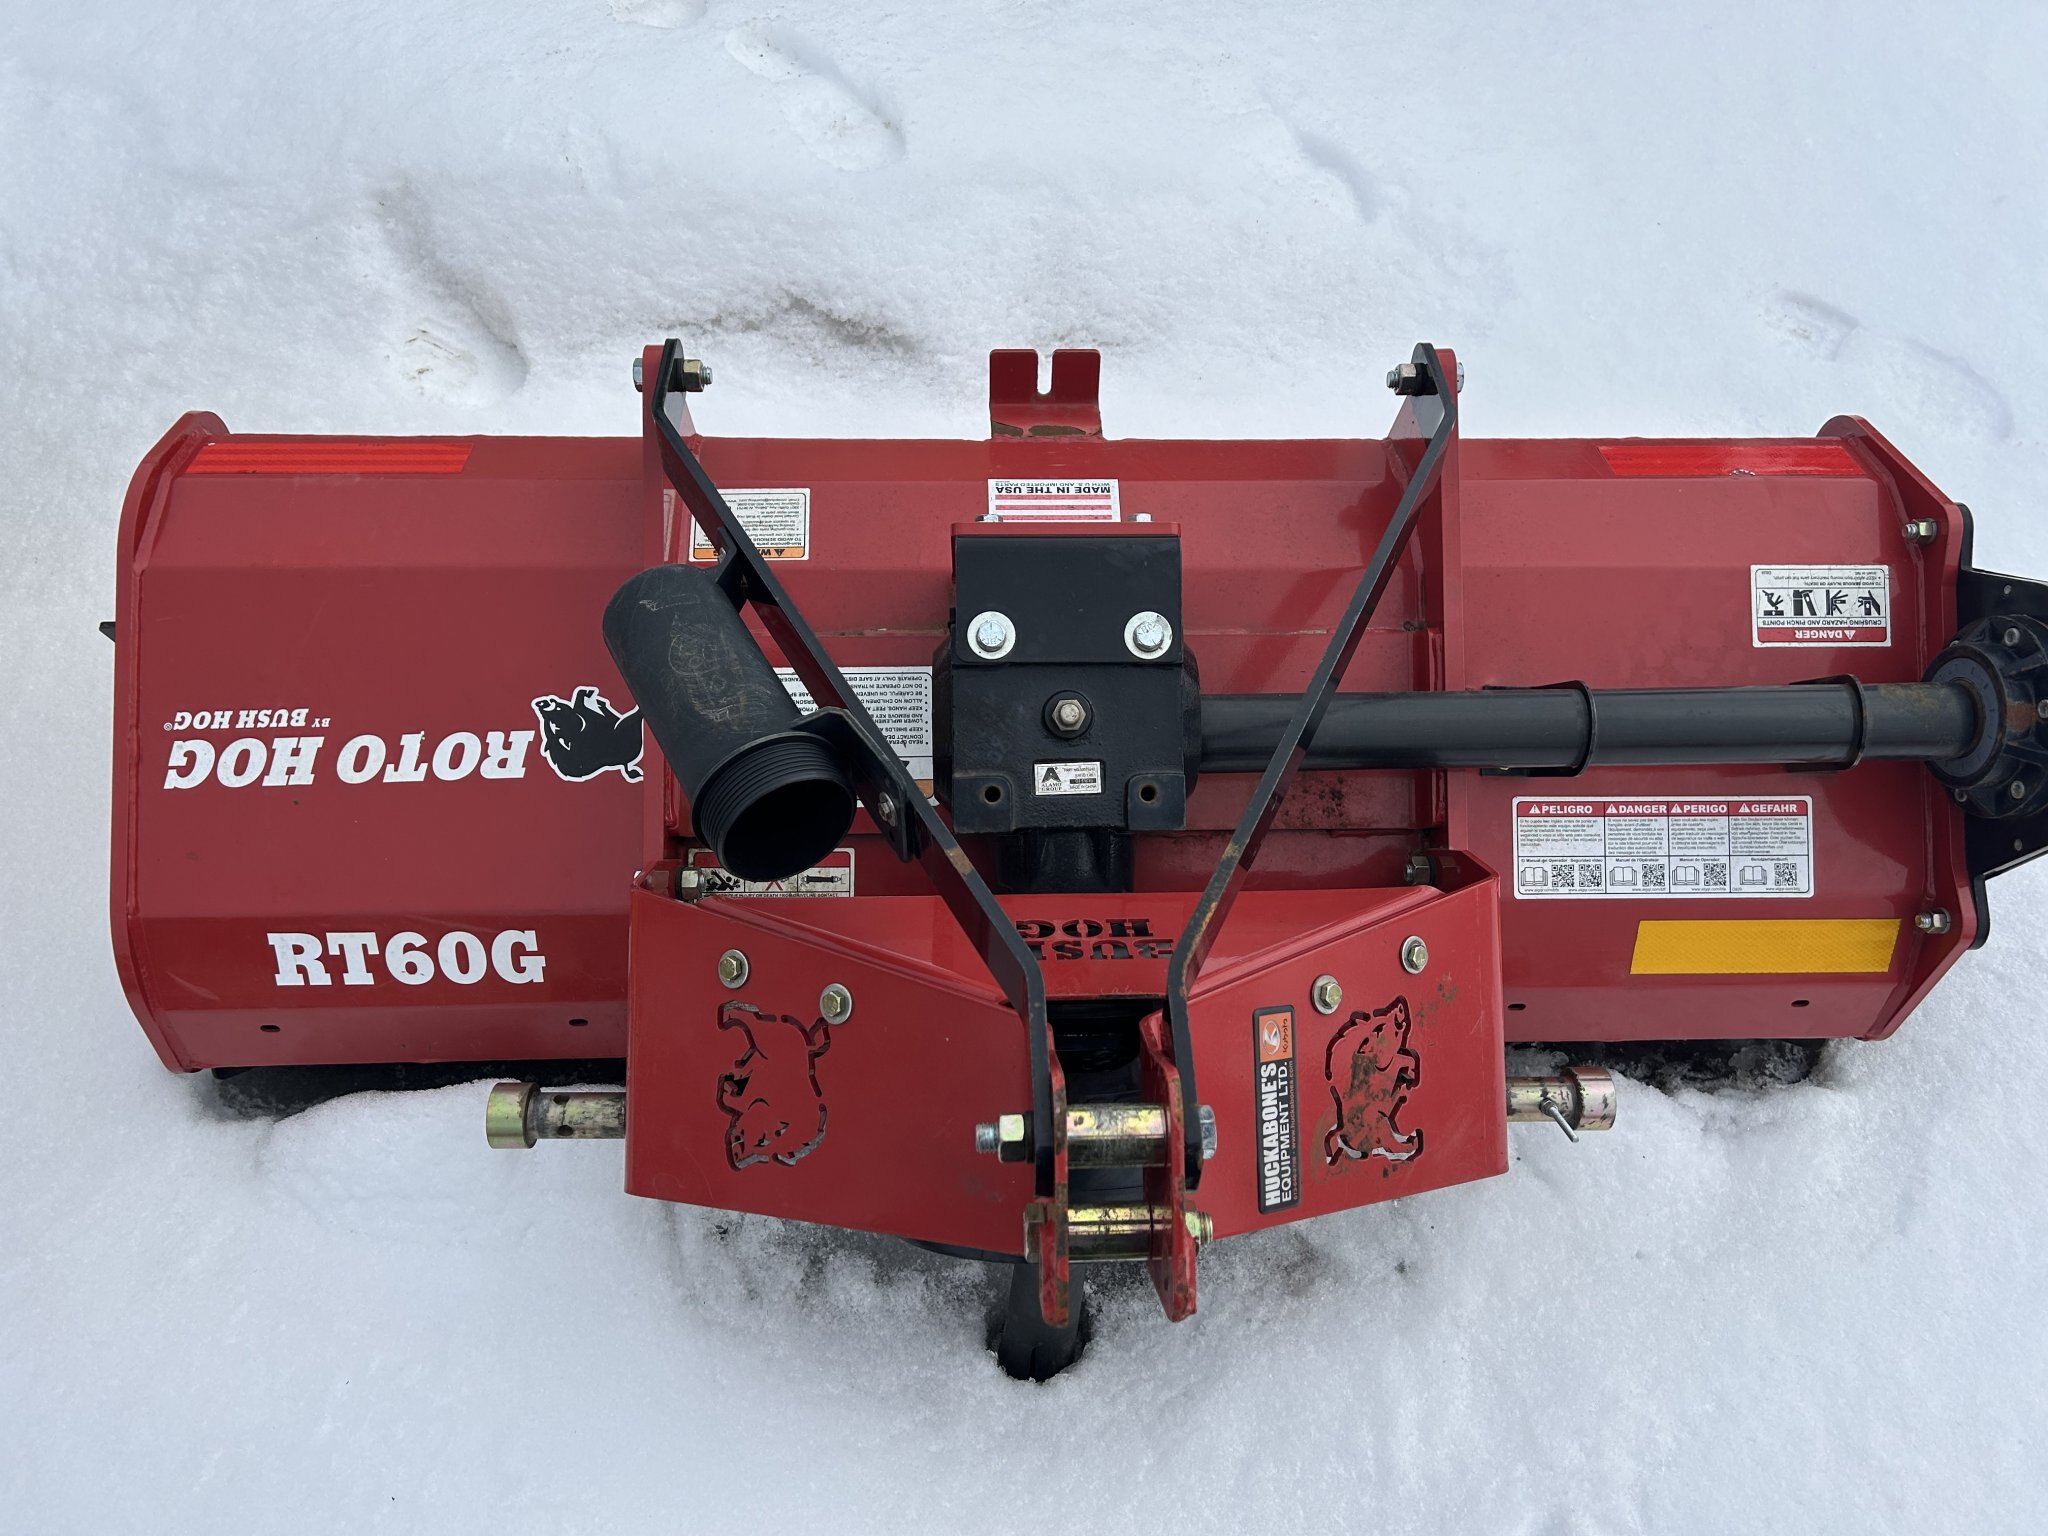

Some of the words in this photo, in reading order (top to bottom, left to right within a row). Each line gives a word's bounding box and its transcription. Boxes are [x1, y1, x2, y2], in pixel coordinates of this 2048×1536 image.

[1795, 630, 1842, 638] DANGER
[236, 708, 309, 729] BUSH
[312, 717, 332, 728] BY
[163, 736, 326, 789] HOG
[337, 730, 536, 784] ROTO
[1542, 805, 1592, 814] PELIGRO
[1618, 805, 1667, 814] DANGER
[1684, 804, 1727, 813] PERIGO
[1751, 804, 1797, 813] GEFAHR
[1015, 919, 1153, 938] HOG
[266, 930, 546, 986] RT60G
[1278, 1062, 1288, 1097] LTD.
[1260, 1062, 1280, 1206] HUCKABONE'S
[1279, 1098, 1292, 1202] EQUIPMENT
